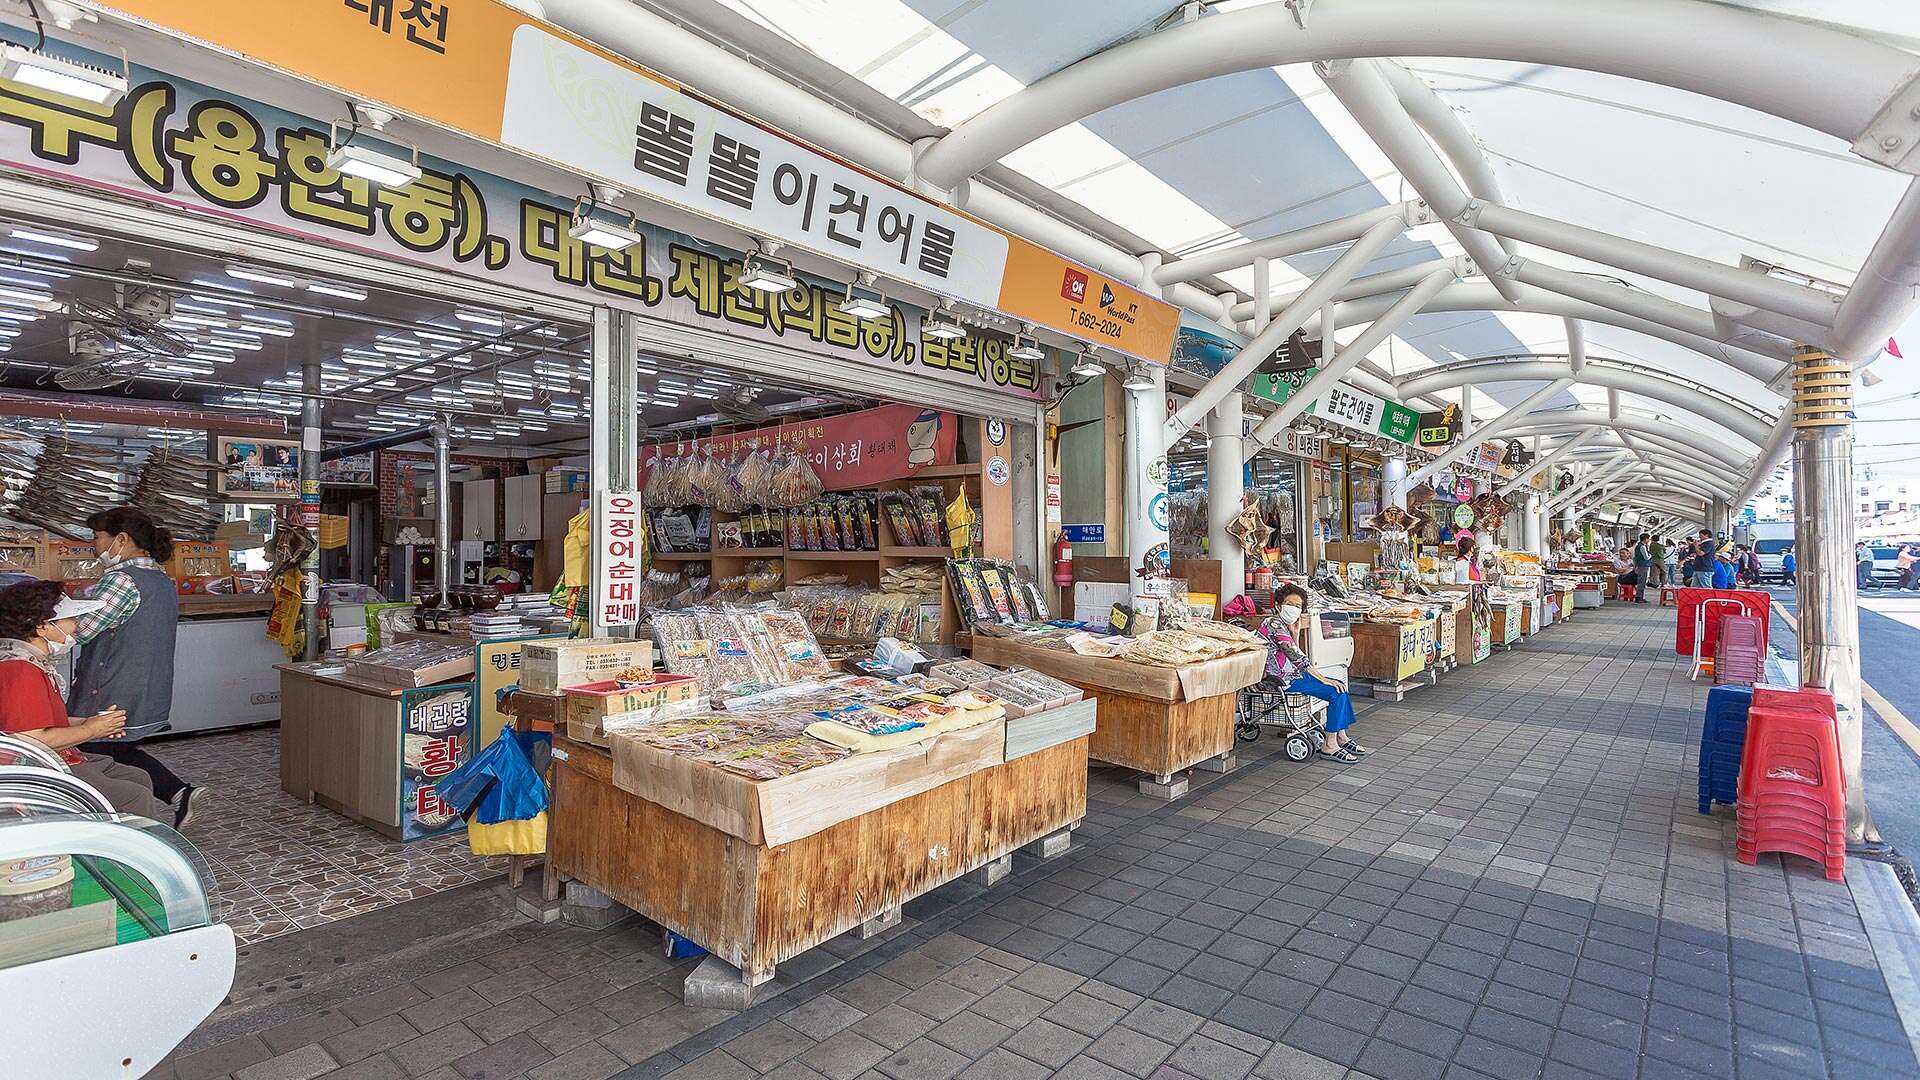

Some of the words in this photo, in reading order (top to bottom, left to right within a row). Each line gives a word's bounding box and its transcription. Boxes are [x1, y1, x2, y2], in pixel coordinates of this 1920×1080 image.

[1072, 280, 1084, 295] OK
[1128, 303, 1138, 314] KT
[1327, 389, 1374, 426] 팔도건어물
[608, 498, 635, 601] 오징어순대
[604, 603, 637, 623] 판매
[410, 700, 468, 732] 대관령
